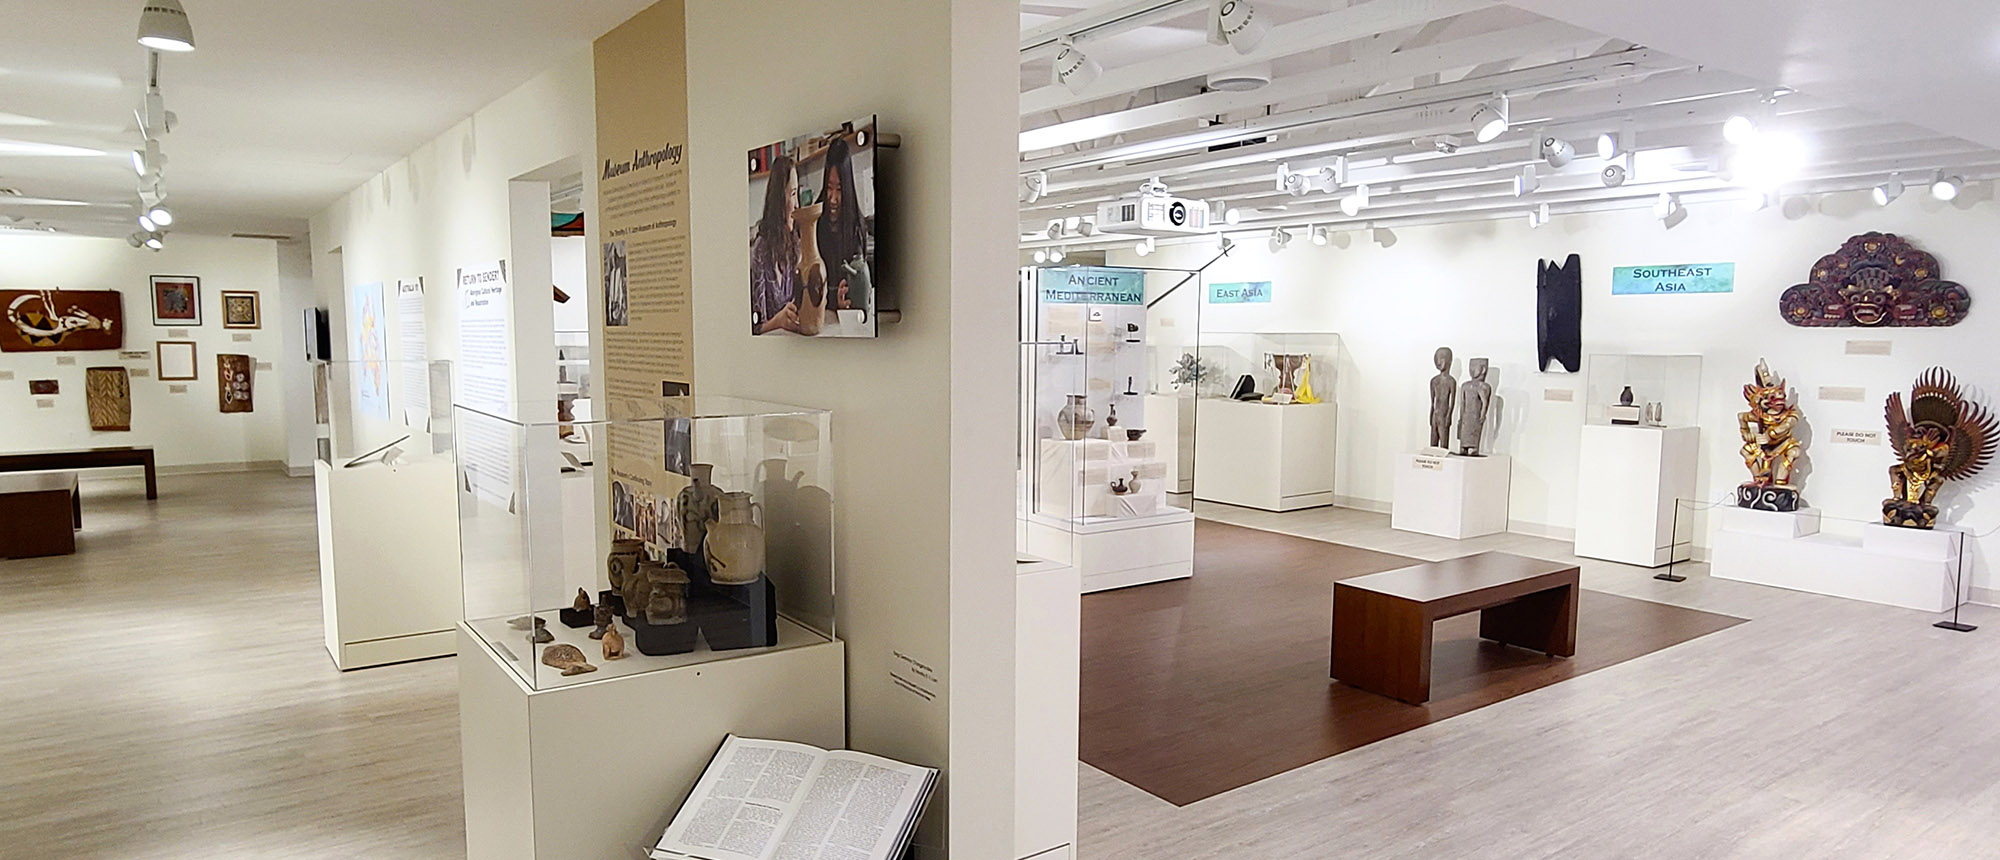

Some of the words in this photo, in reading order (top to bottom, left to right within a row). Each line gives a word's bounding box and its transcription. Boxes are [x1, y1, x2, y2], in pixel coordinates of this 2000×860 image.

[602, 159, 630, 181] Museum
[632, 142, 683, 171] Anthropology
[463, 274, 476, 285] RETURN
[477, 273, 482, 284] TO
[1633, 267, 1712, 279] SOUTHEAST
[1068, 274, 1119, 287] ANCIENT
[1216, 288, 1240, 298] EAST
[1241, 287, 1263, 298] ASIA
[1654, 282, 1687, 292] ASIA
